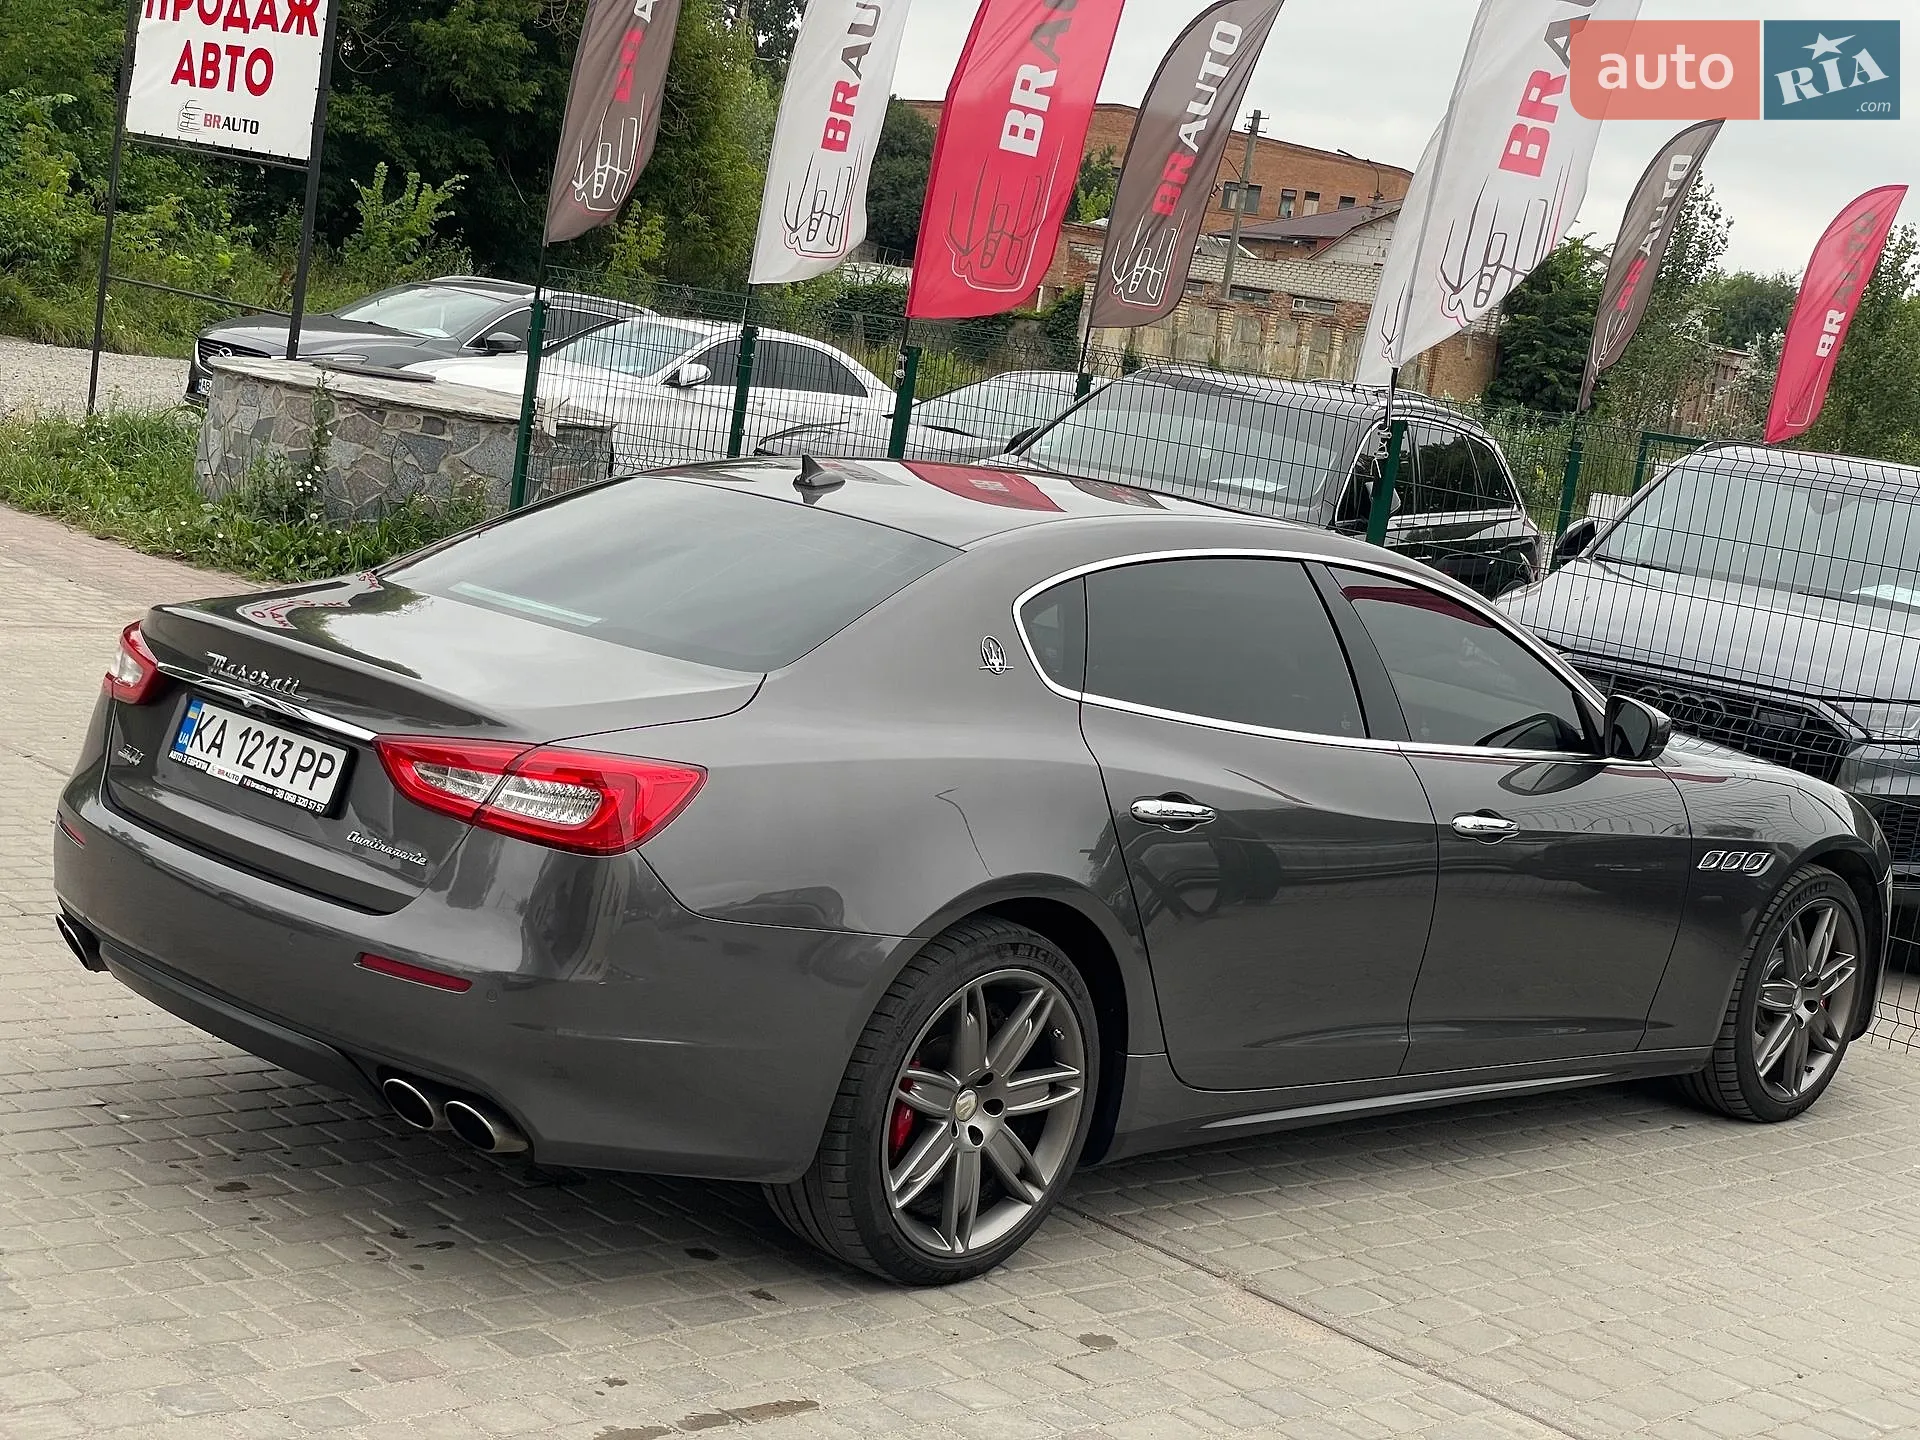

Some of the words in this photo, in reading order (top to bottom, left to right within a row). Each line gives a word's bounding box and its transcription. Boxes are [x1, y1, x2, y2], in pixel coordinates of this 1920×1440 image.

[171, 40, 274, 96] АВТО
[999, 0, 1079, 158] BRA
[1498, 0, 1598, 177] BRA
[203, 112, 260, 135] BRAUTO
[1151, 20, 1243, 217] BRAUTO
[1815, 211, 1876, 357] BRAUTO
[205, 650, 309, 702] Maserati
[177, 731, 189, 746] UA
[189, 711, 229, 759] KA
[235, 725, 294, 779] 1213
[289, 744, 337, 792] PP
